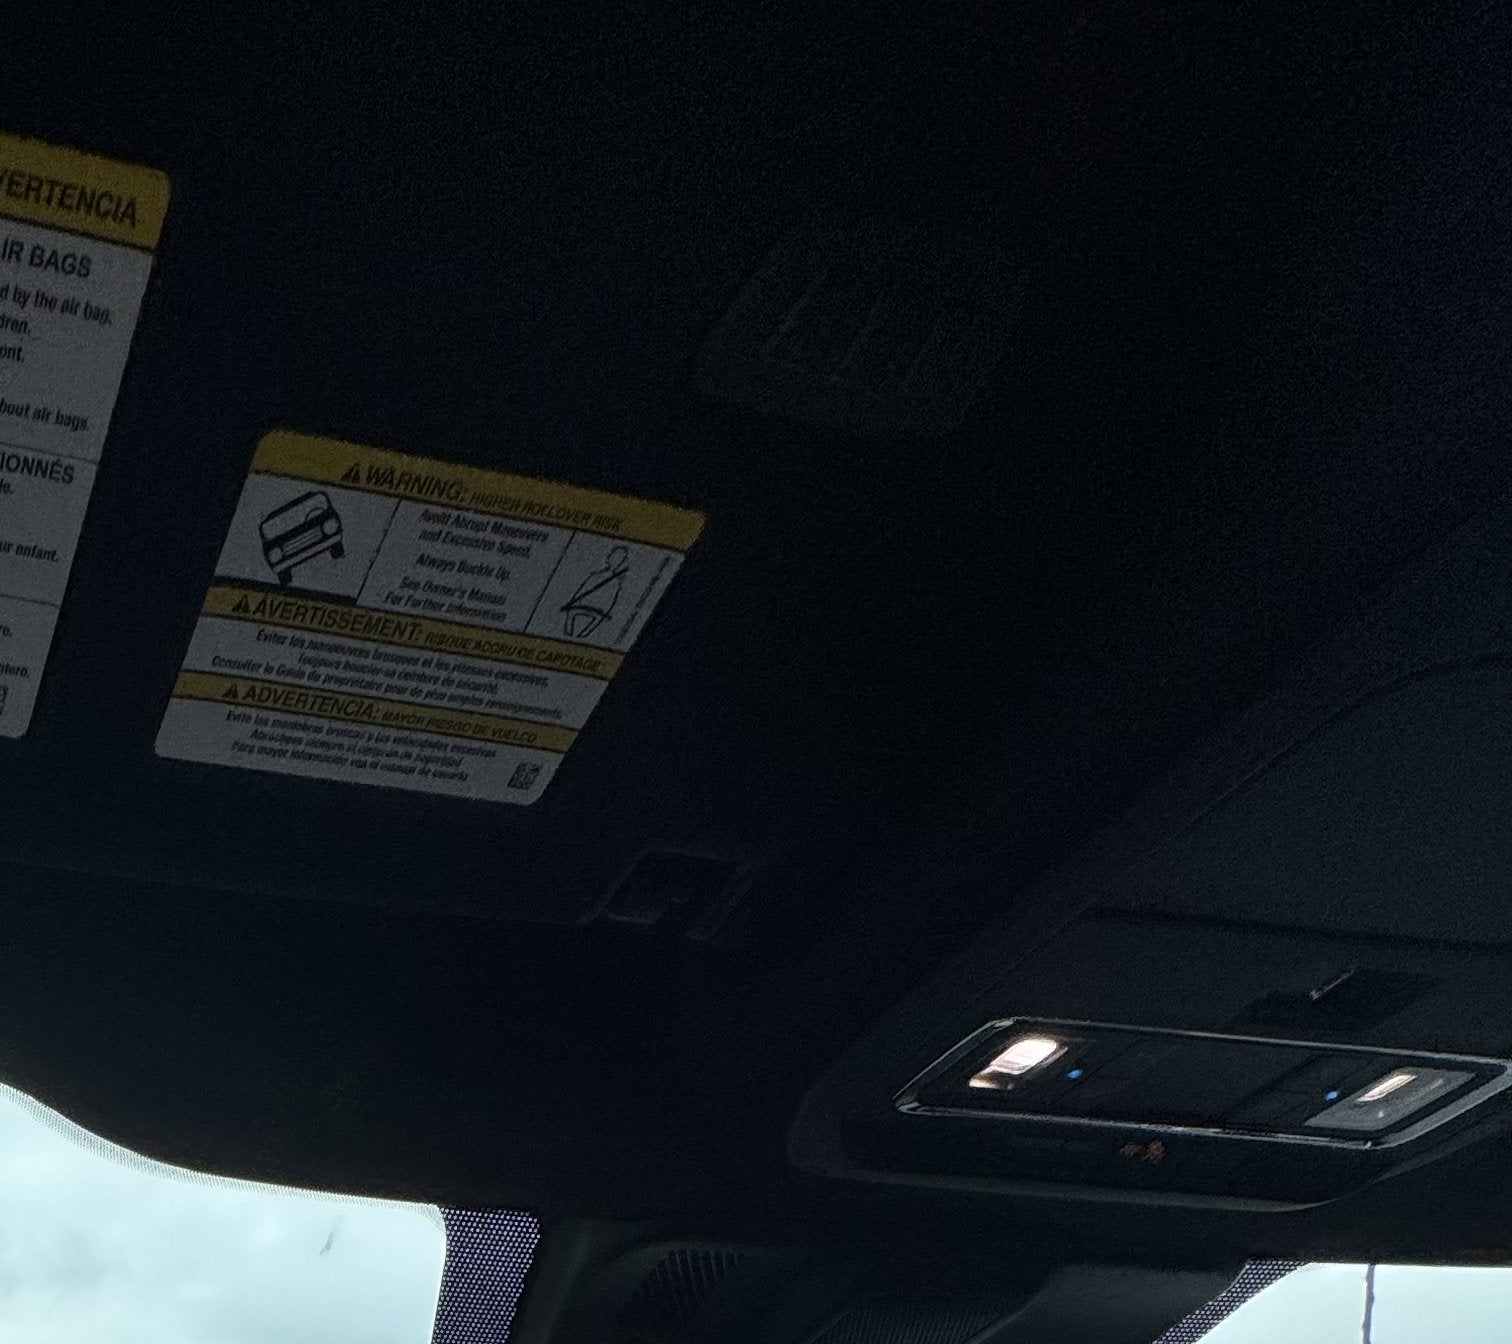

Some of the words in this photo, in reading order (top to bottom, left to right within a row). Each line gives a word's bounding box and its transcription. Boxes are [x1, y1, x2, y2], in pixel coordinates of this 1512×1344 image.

[27, 243, 94, 279] BAGS
[10, 285, 31, 309] by
[33, 290, 58, 312] the
[60, 295, 80, 316] air
[31, 404, 52, 422] air
[364, 466, 470, 502] WARNING:
[251, 597, 426, 641] AVERTISSEMENT:
[241, 685, 383, 720] ADVERTENCIA:
[472, 724, 490, 735] DE
